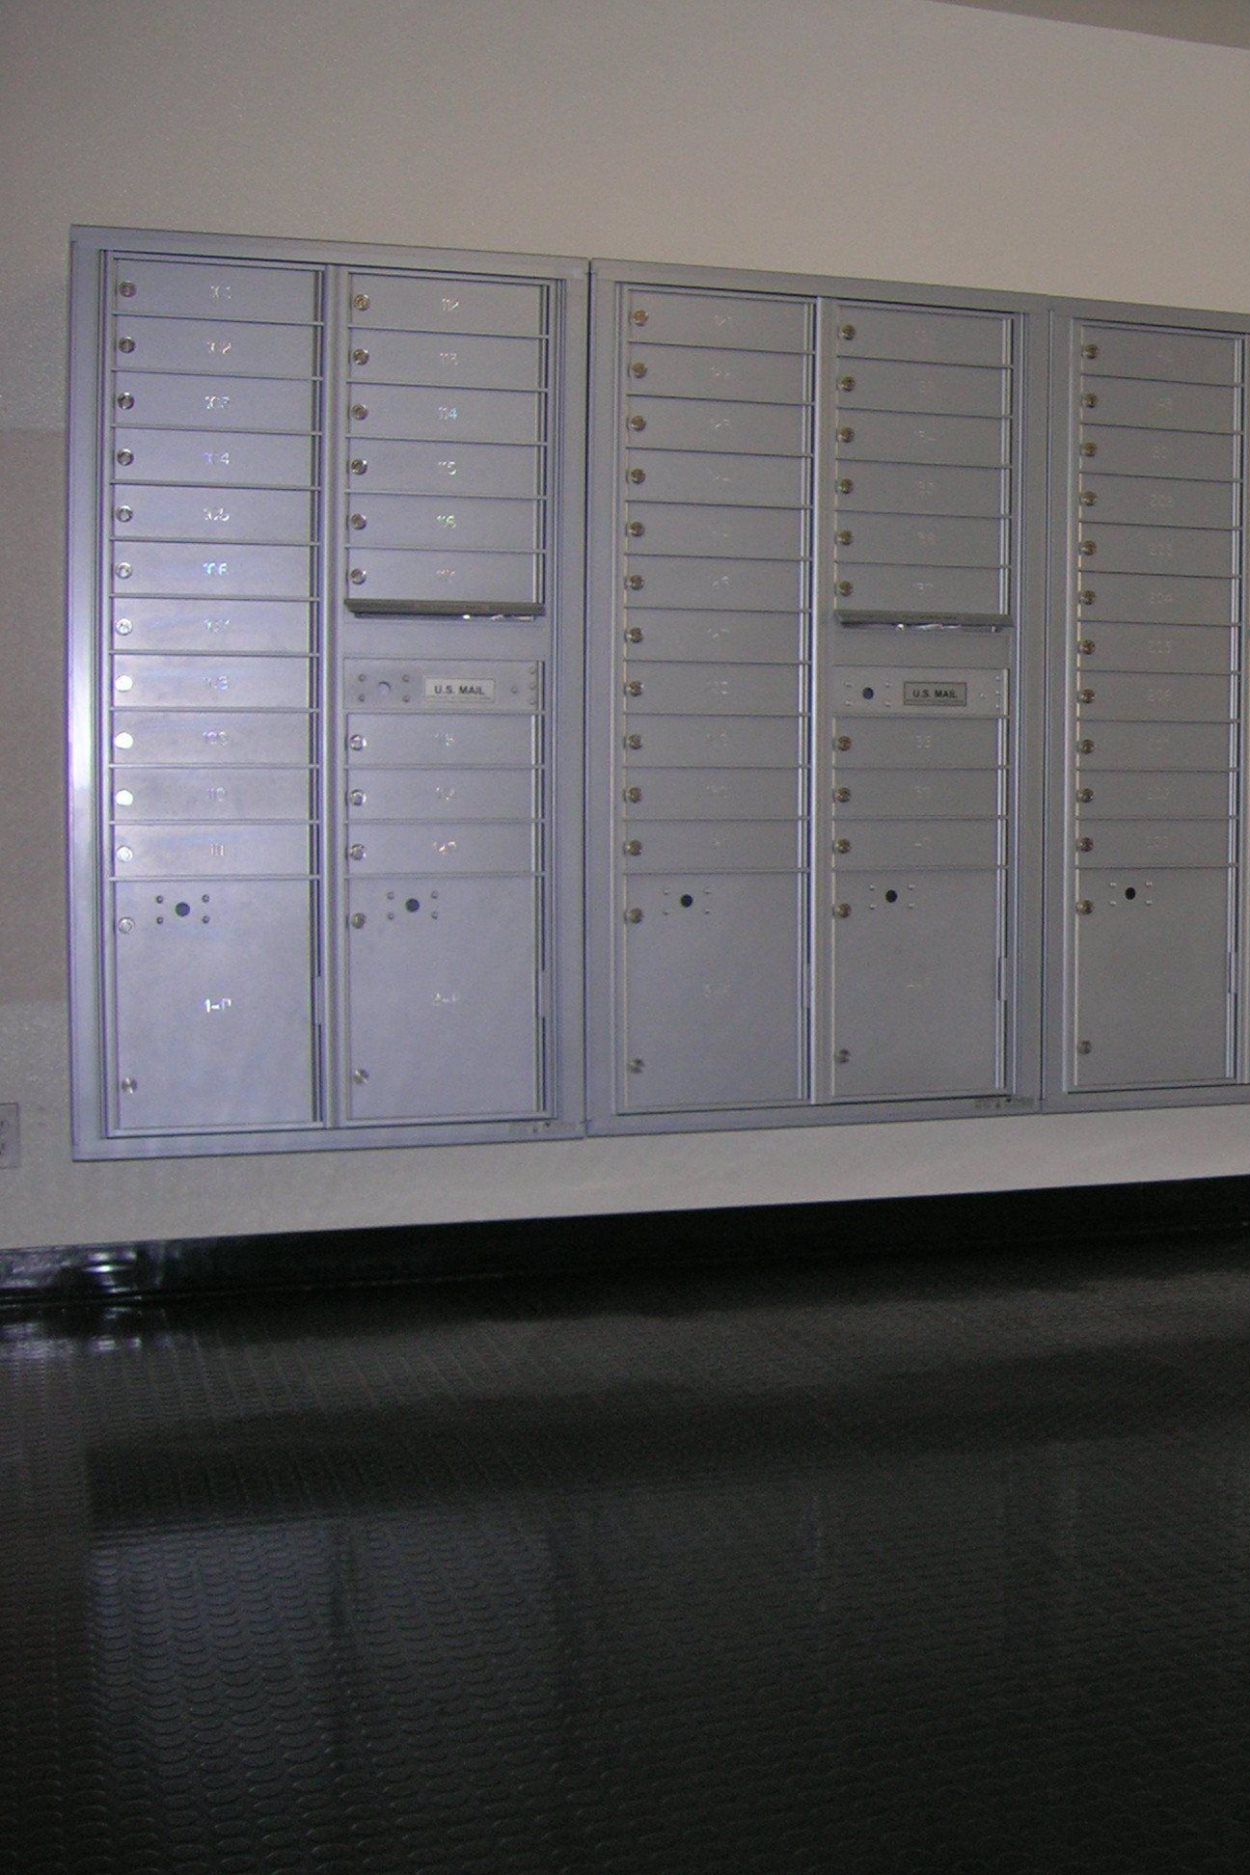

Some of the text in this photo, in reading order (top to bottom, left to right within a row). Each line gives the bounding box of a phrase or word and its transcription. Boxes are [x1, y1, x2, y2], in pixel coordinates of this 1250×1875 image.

[433, 685, 485, 697] U.S. MAIL
[912, 689, 957, 700] U.S. MAIL
